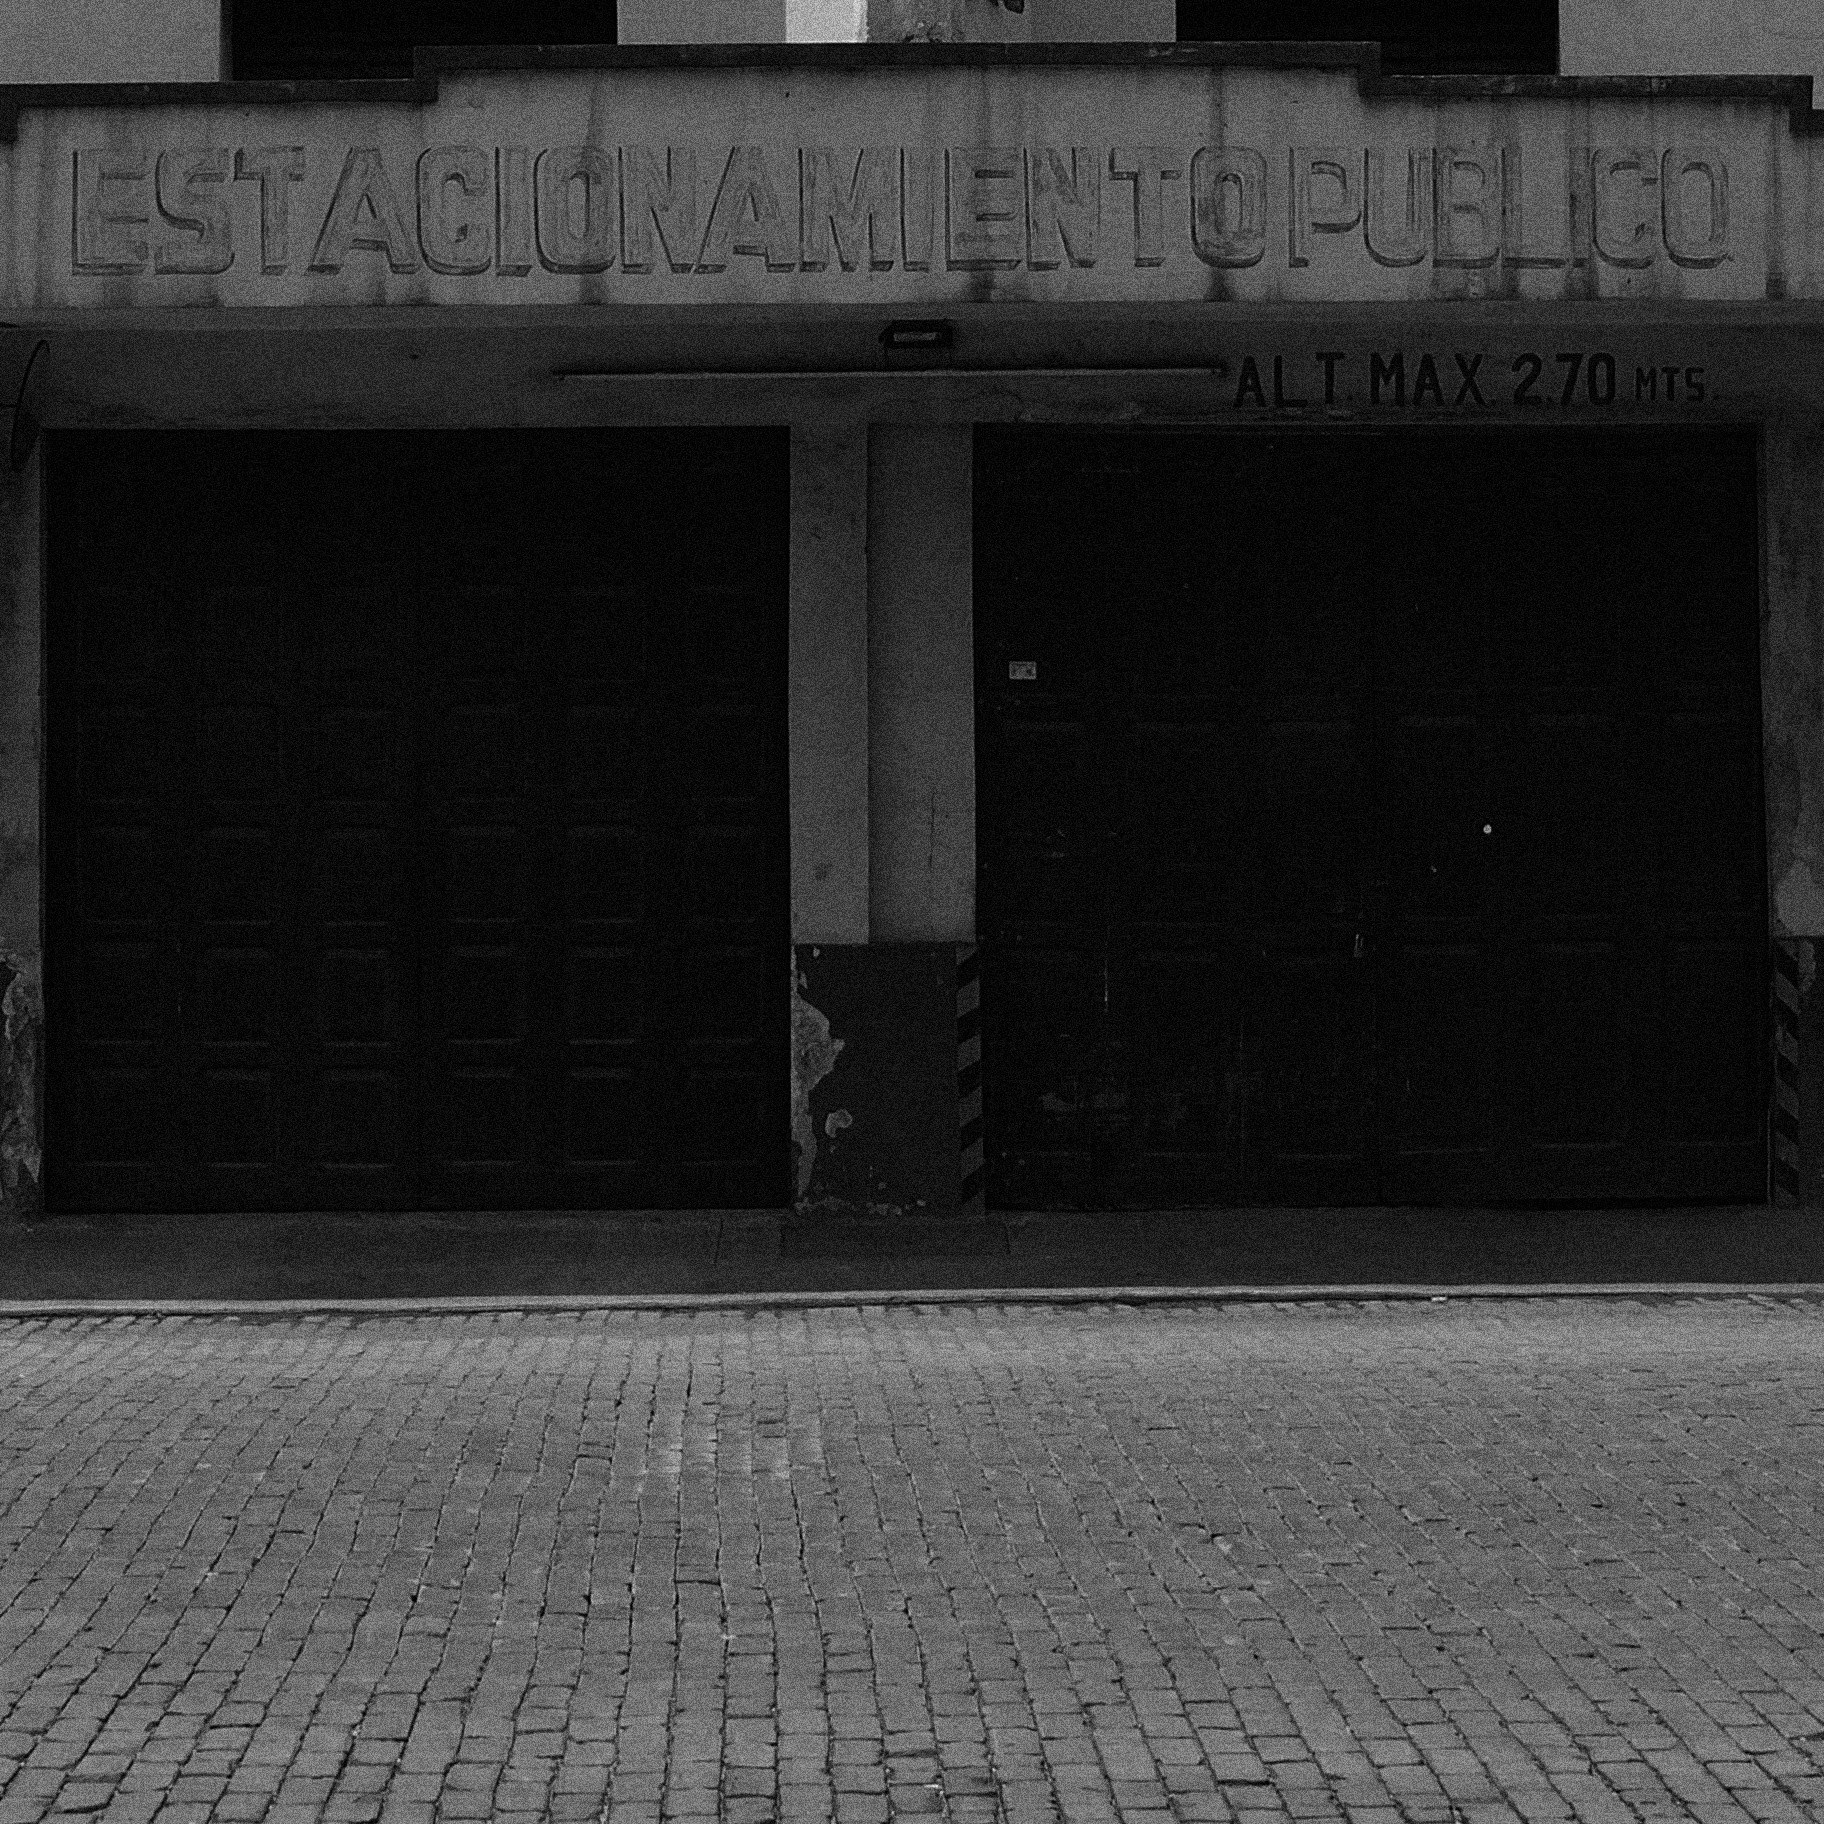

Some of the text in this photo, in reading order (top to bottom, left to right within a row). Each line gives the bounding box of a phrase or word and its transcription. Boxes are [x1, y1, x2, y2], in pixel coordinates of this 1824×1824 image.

[71, 144, 1734, 277] ESTACIONAMIENTO PUBLICO
[1511, 353, 1617, 407] 2.70
